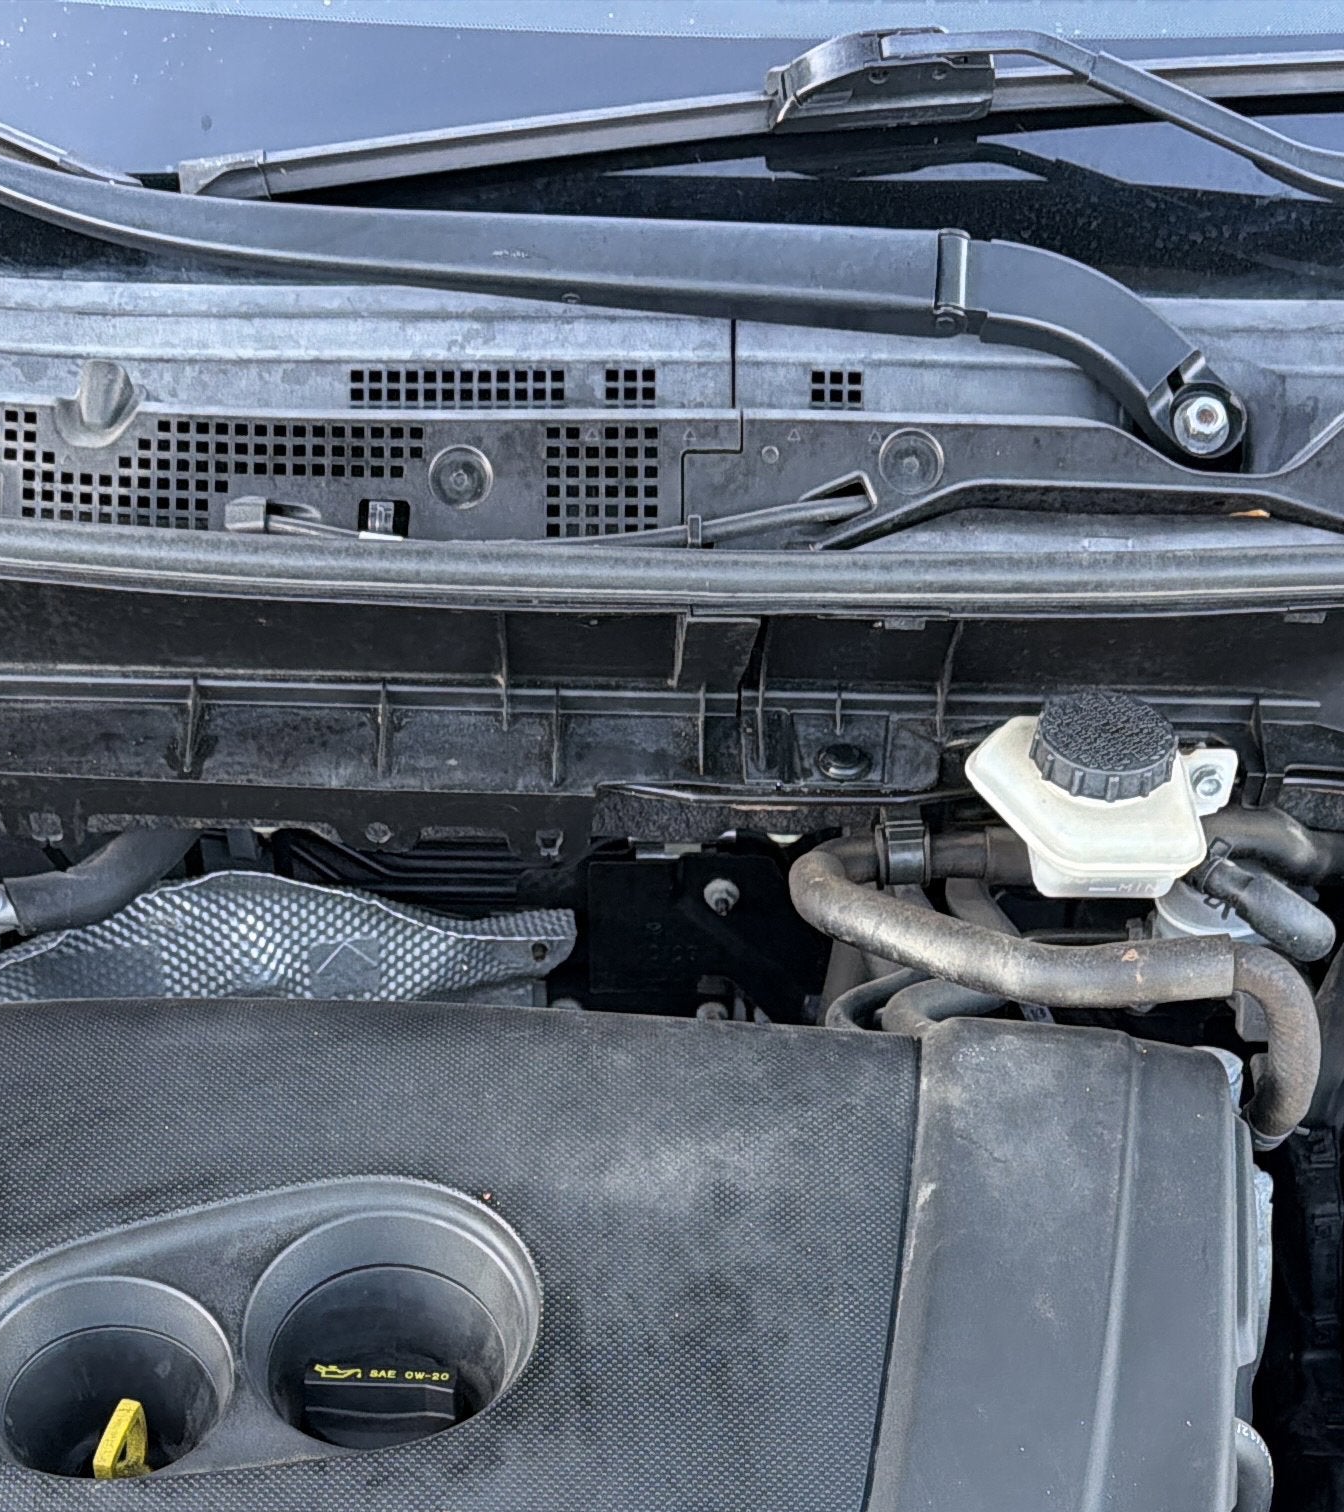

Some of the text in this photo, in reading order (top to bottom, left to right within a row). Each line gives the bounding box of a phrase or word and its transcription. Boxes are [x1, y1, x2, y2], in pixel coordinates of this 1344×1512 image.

[1118, 883, 1158, 893] MIN
[369, 1369, 450, 1381] SAE 0W-20
